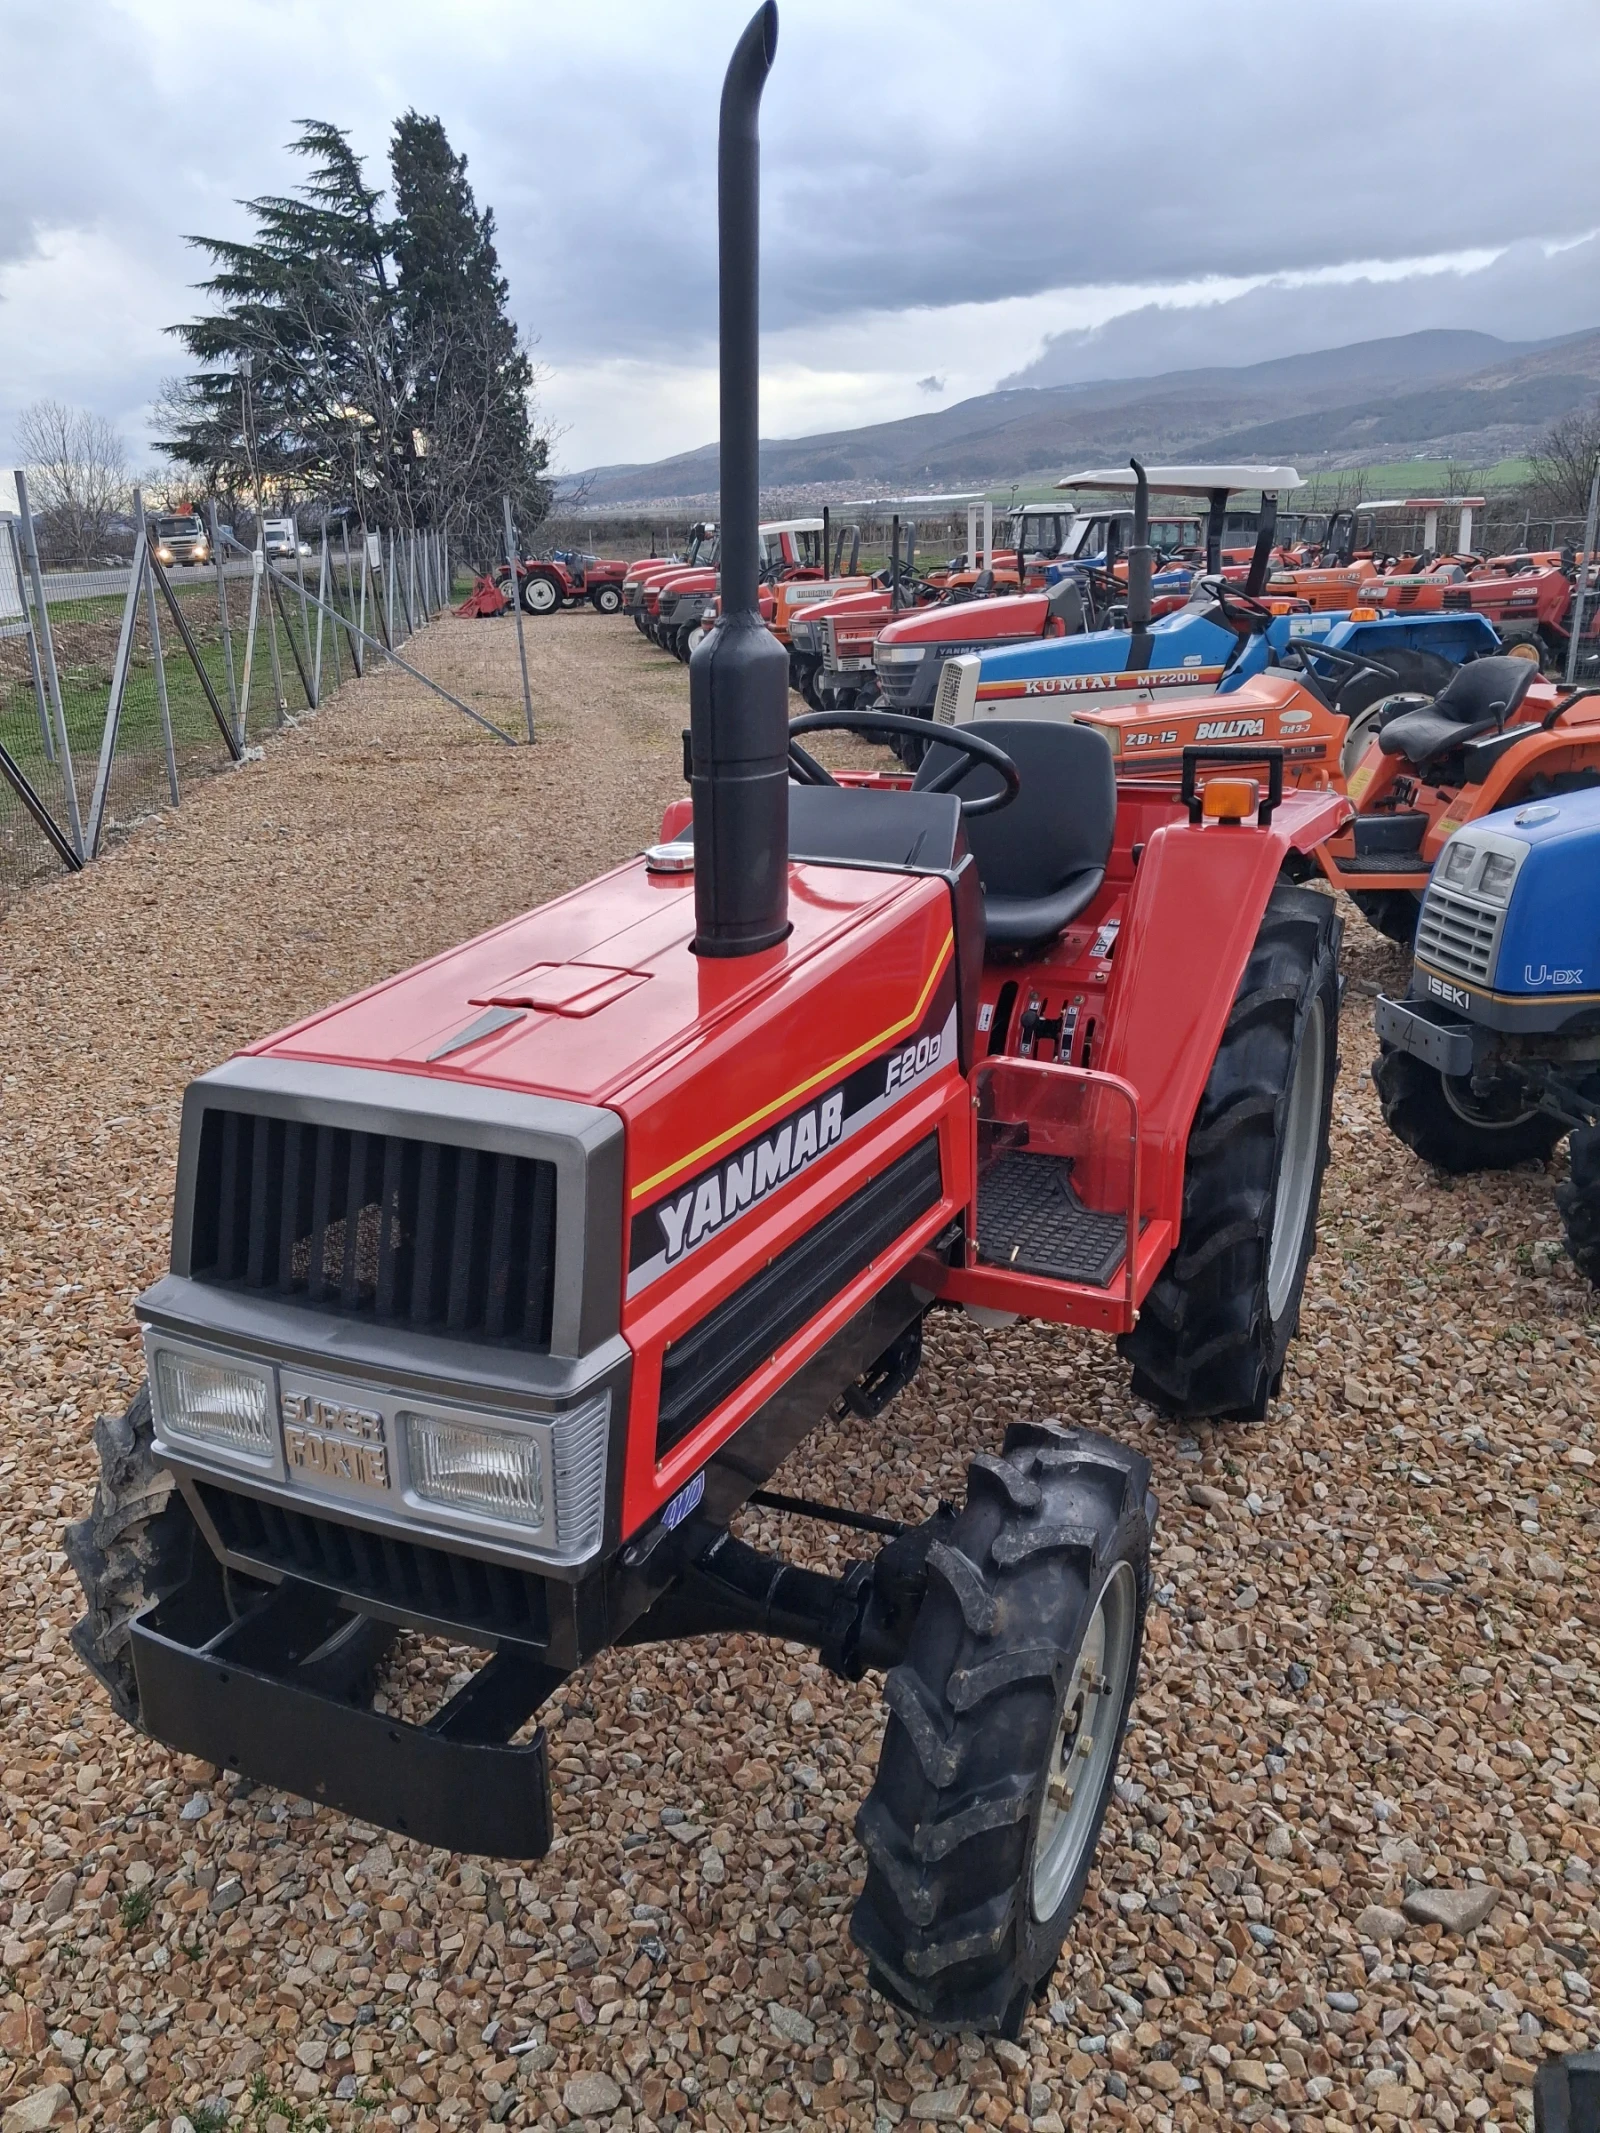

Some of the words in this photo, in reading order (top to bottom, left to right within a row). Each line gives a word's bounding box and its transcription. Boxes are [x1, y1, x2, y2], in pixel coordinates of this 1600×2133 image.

[1025, 676, 1118, 694] KUMIAI
[1137, 671, 1200, 686] MT2201D
[1195, 718, 1265, 741] BULLTRA
[1427, 975, 1470, 1010] ISEKI
[884, 1033, 943, 1096] F20D
[657, 1089, 844, 1263] YANMAR
[281, 1390, 385, 1442] SUPER
[284, 1422, 391, 1489] FORTE
